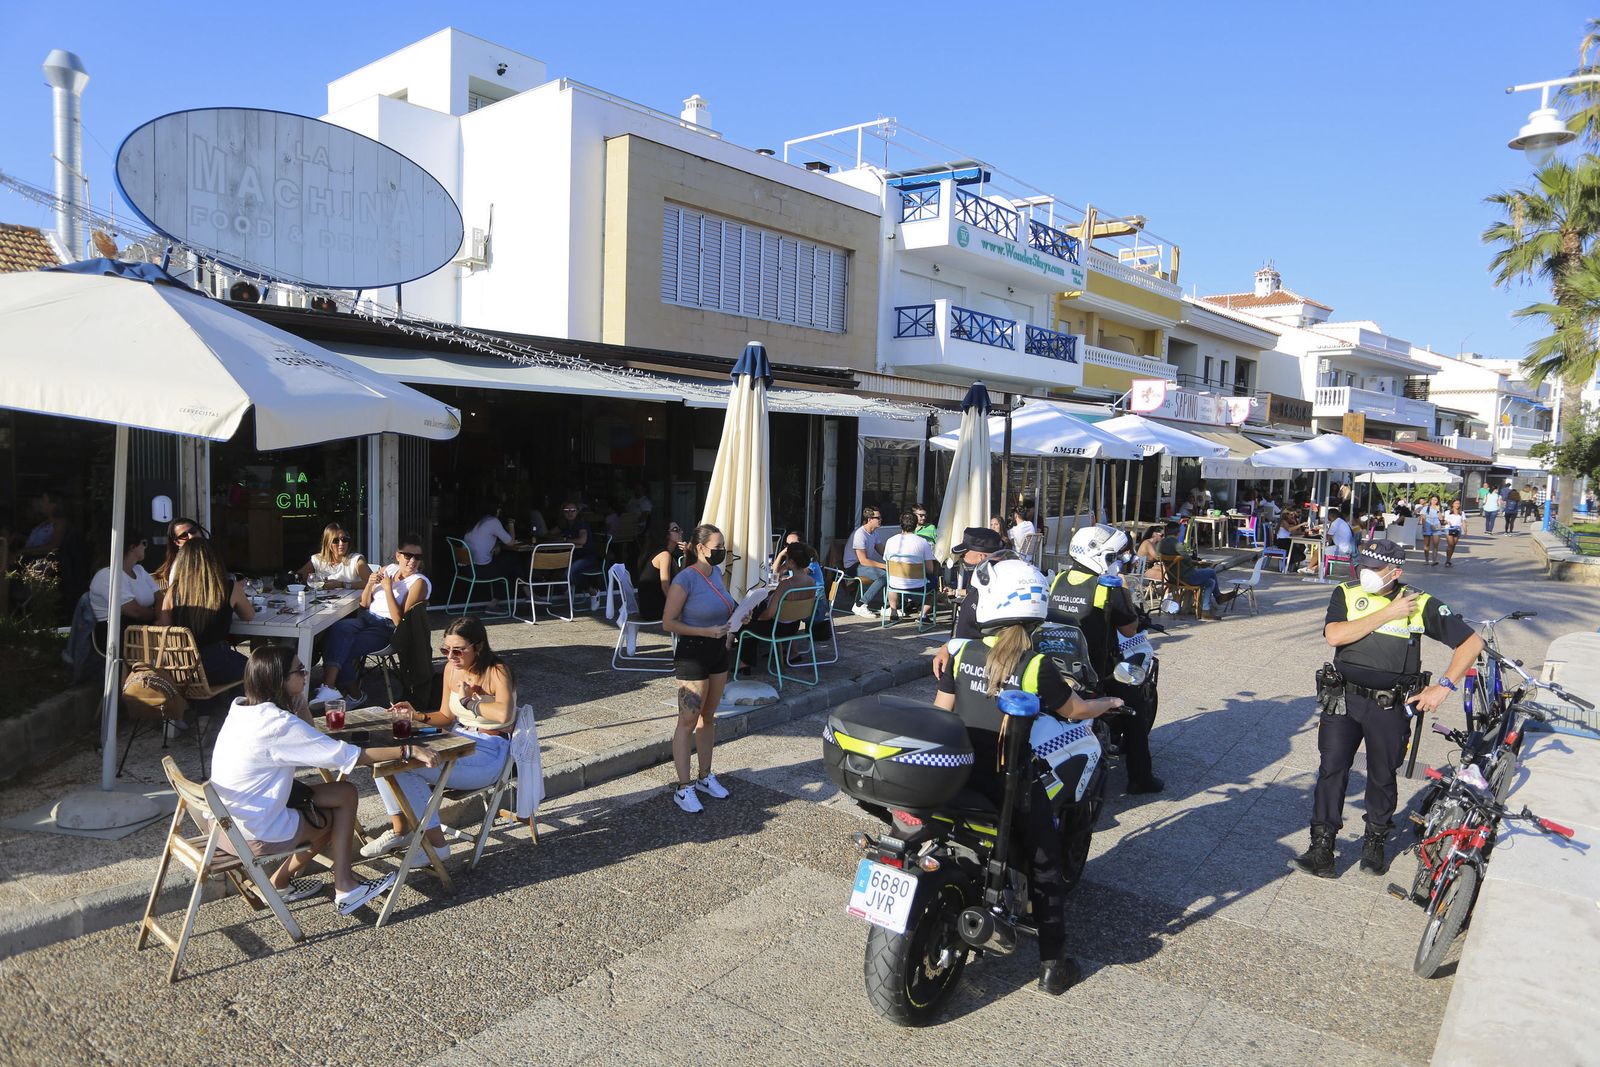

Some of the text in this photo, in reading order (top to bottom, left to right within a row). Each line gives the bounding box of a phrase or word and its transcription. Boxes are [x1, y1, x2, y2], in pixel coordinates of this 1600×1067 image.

[294, 140, 331, 168] LA
[192, 133, 415, 226] MACHINA
[190, 204, 273, 240] FOOD
[285, 472, 308, 483] LA
[276, 493, 318, 509] CH
[1070, 596, 1087, 605] LOCAL
[871, 870, 910, 898] 6680
[865, 890, 895, 915] JVR
